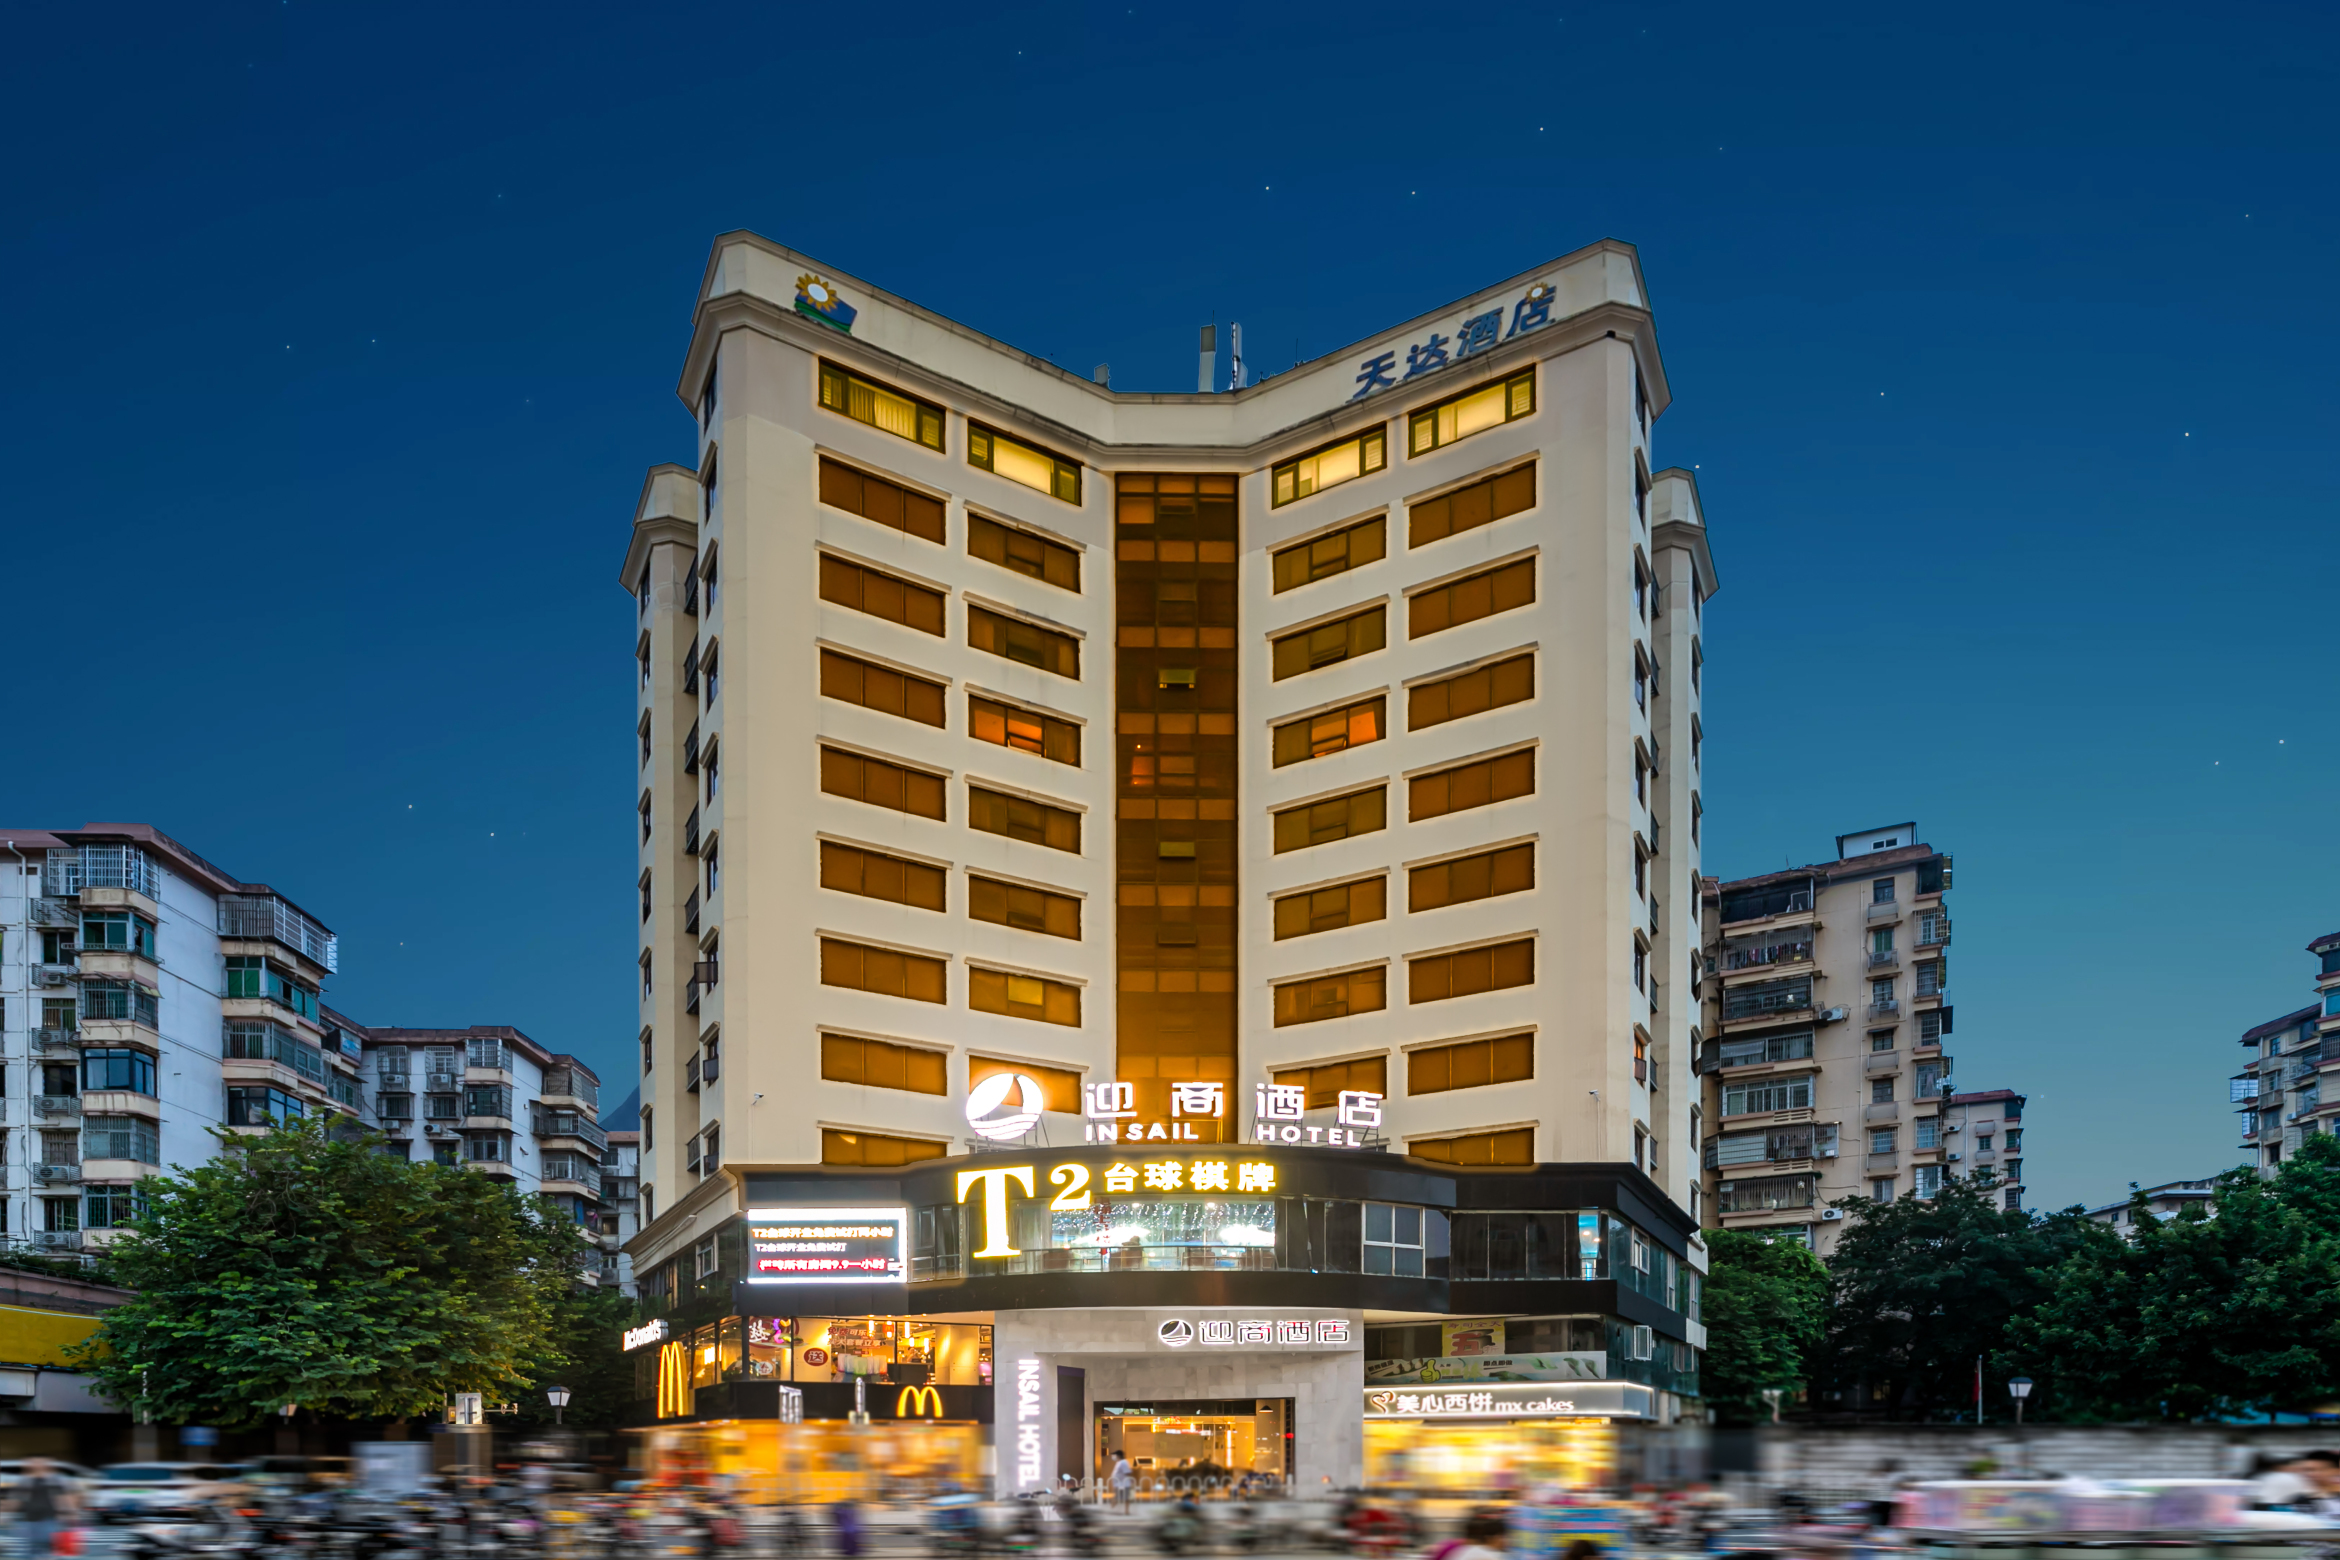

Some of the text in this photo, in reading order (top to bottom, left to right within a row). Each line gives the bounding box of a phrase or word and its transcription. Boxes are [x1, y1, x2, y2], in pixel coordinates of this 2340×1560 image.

[1353, 283, 1557, 400] 天达酒店
[1085, 1081, 1384, 1127] 迎商酒店
[1257, 1124, 1362, 1147] HOTEL
[1104, 1160, 1277, 1193] 台球棋牌
[1198, 1318, 1351, 1345] 迎商酒店
[1396, 1392, 1574, 1413] 美心西饼 mx cakes
[1017, 1359, 1041, 1487] INSAIL HOTEL
